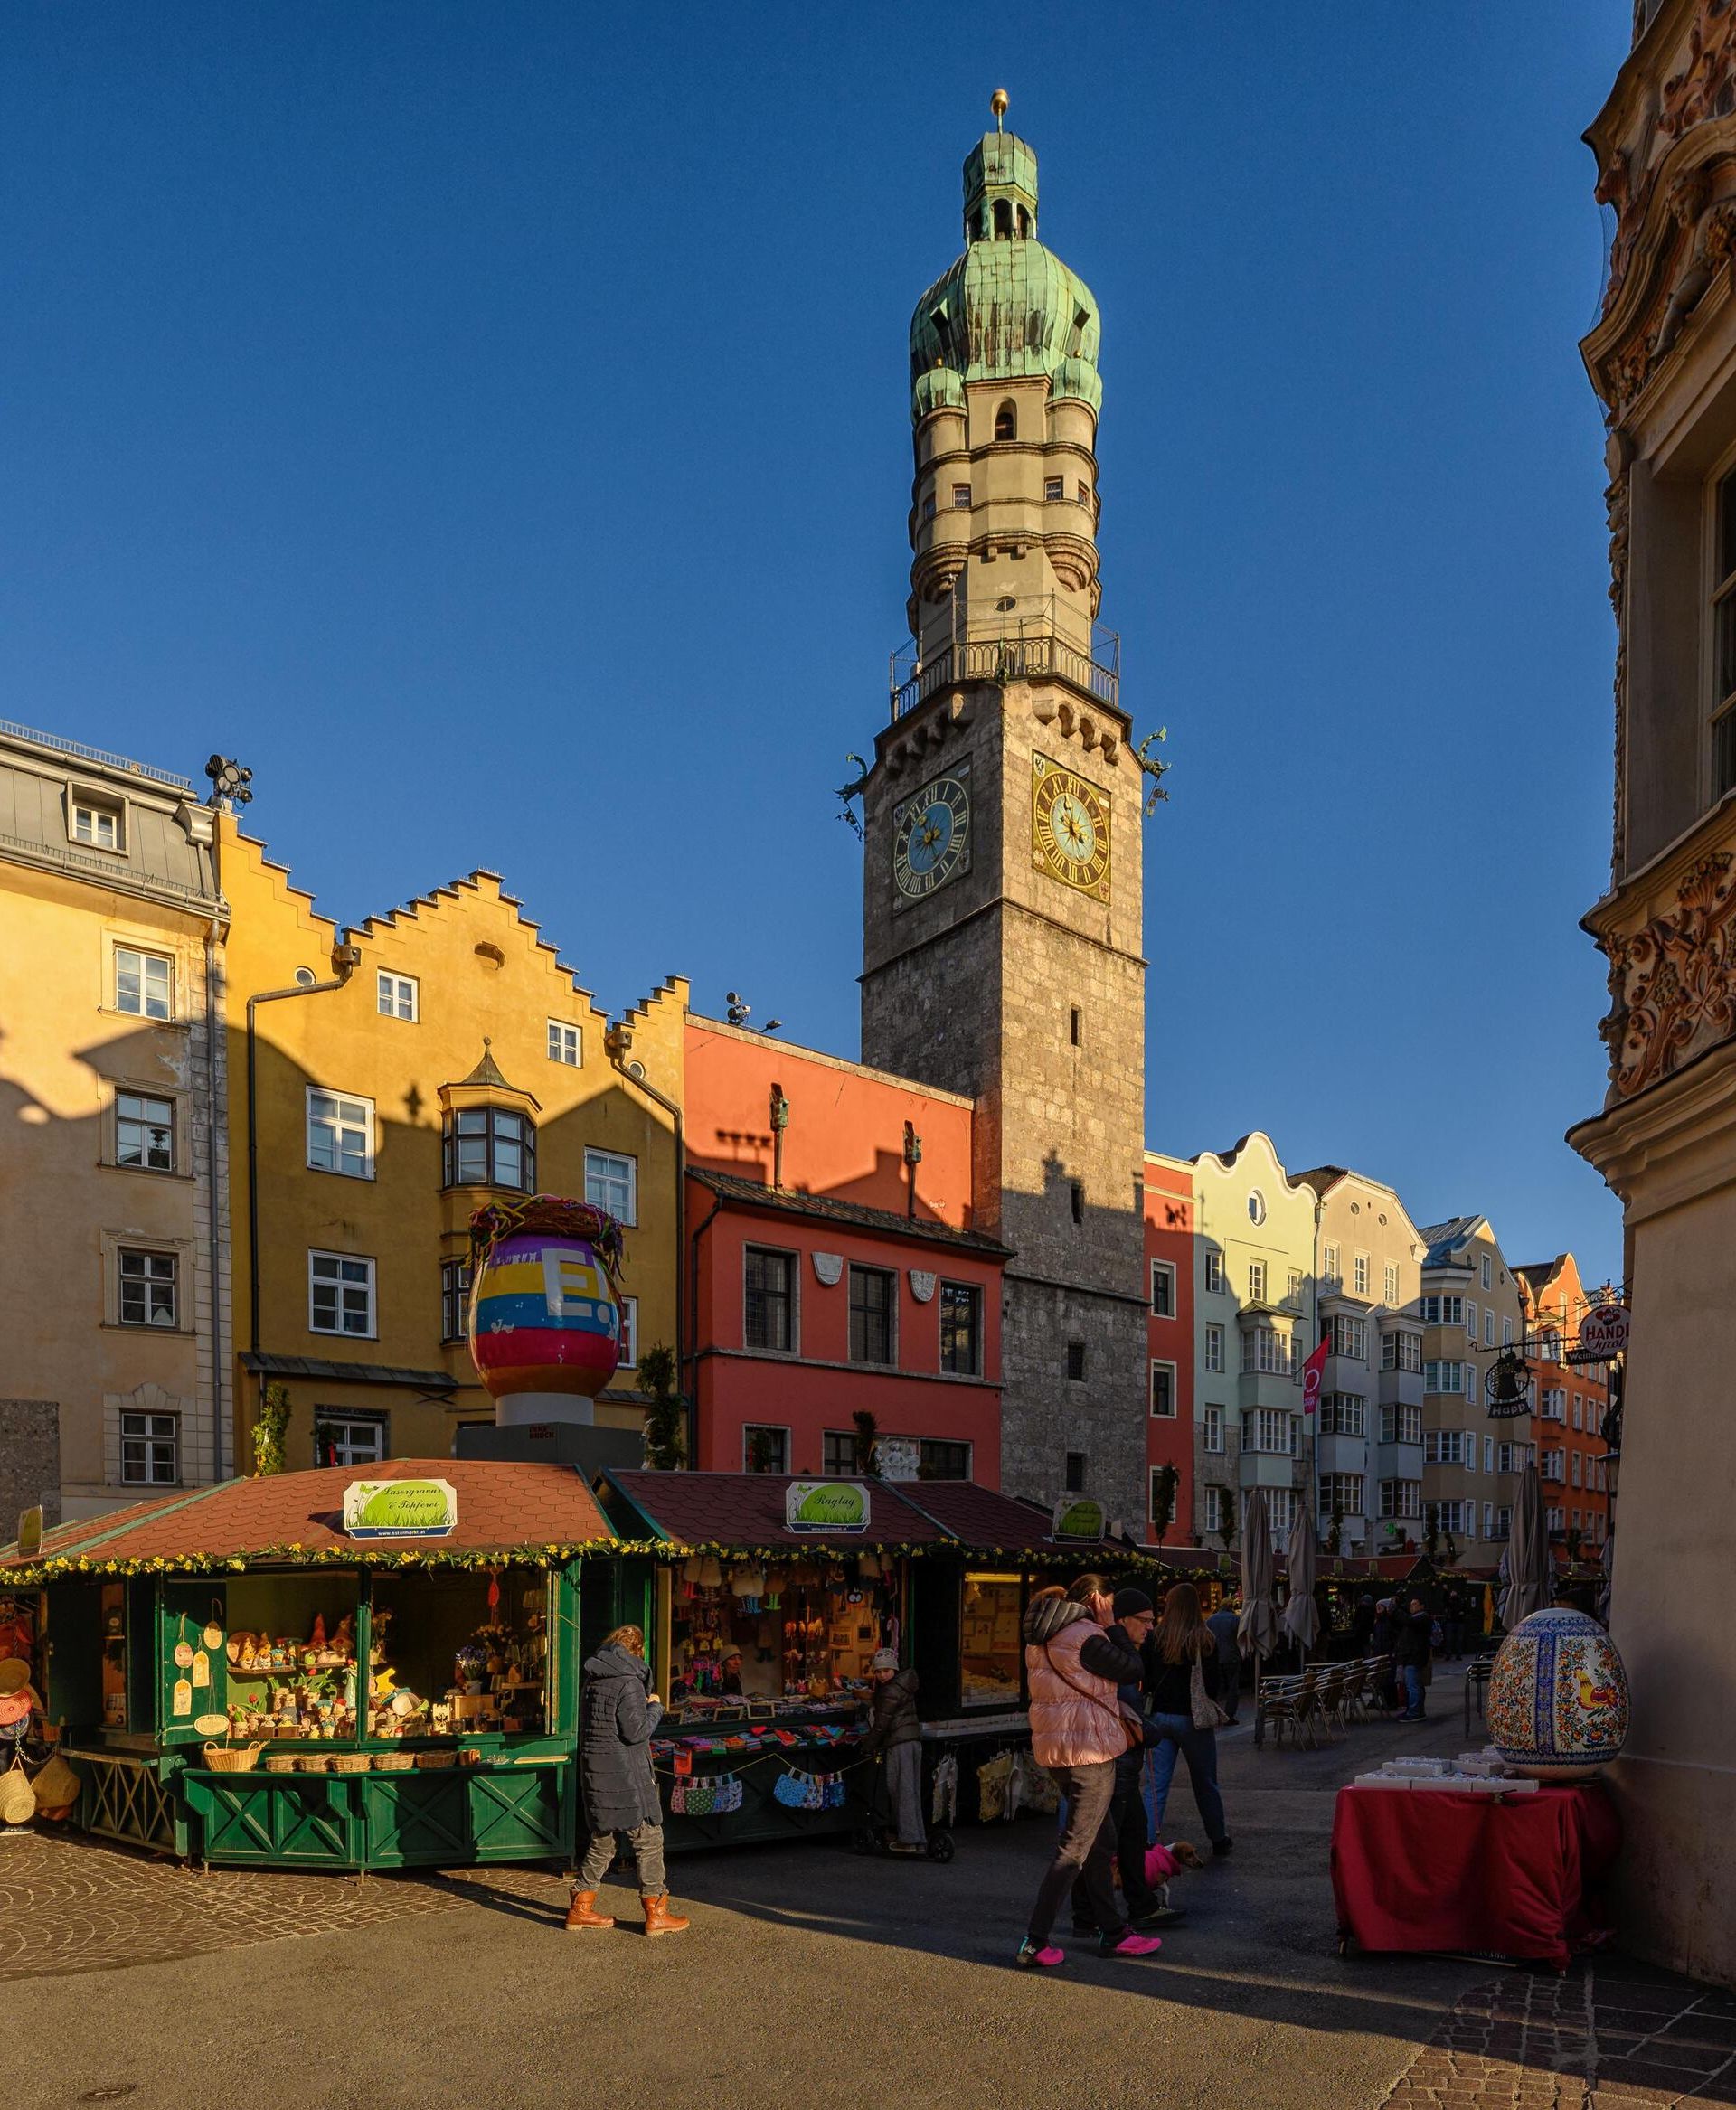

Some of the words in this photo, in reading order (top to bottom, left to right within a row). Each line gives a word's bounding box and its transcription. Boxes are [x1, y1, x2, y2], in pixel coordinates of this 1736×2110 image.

[1588, 1337, 1625, 1353] Tyrol
[383, 1487, 441, 1497] Lasergravur
[814, 1494, 855, 1510] Ragtag
